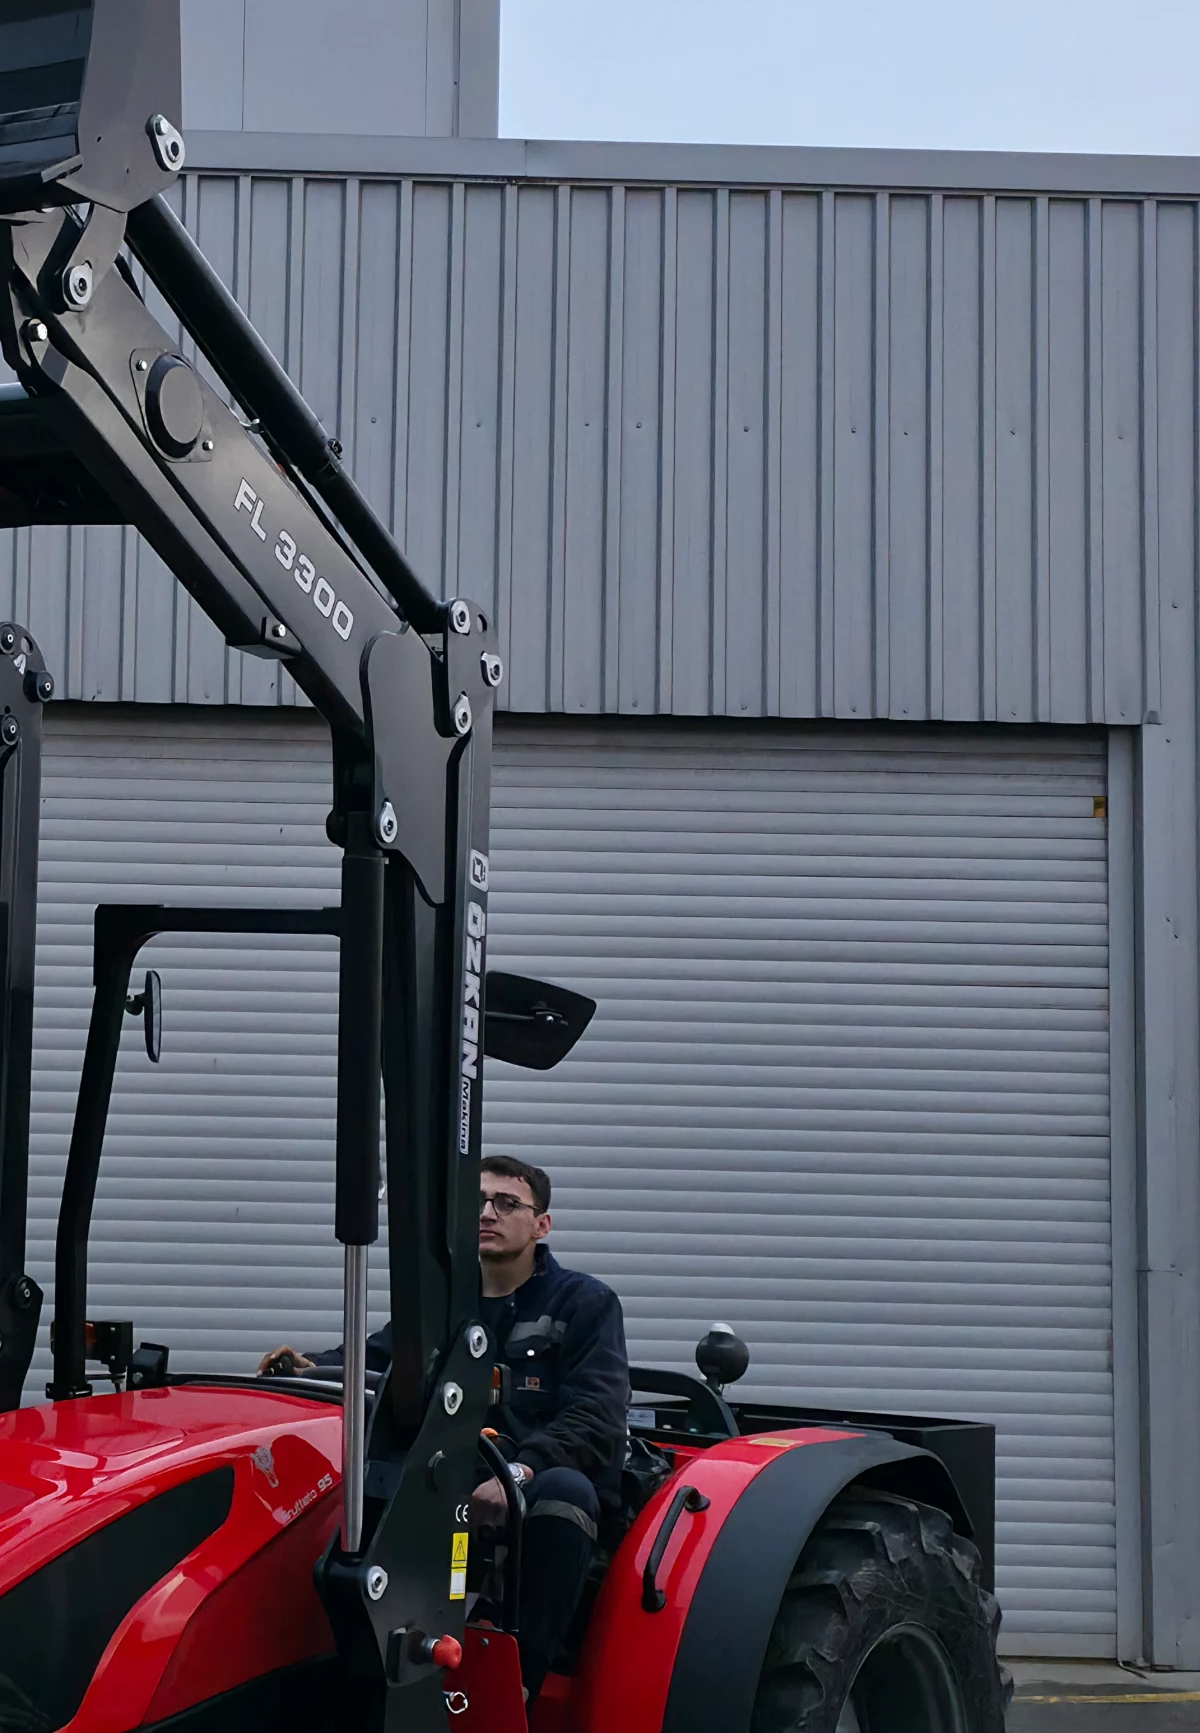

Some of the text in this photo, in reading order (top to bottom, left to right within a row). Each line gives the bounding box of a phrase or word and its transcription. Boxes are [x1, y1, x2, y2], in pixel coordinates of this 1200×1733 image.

[234, 477, 354, 641] FL 3300
[461, 901, 486, 1080] ÖZKAN
[317, 1473, 333, 1492] 95
